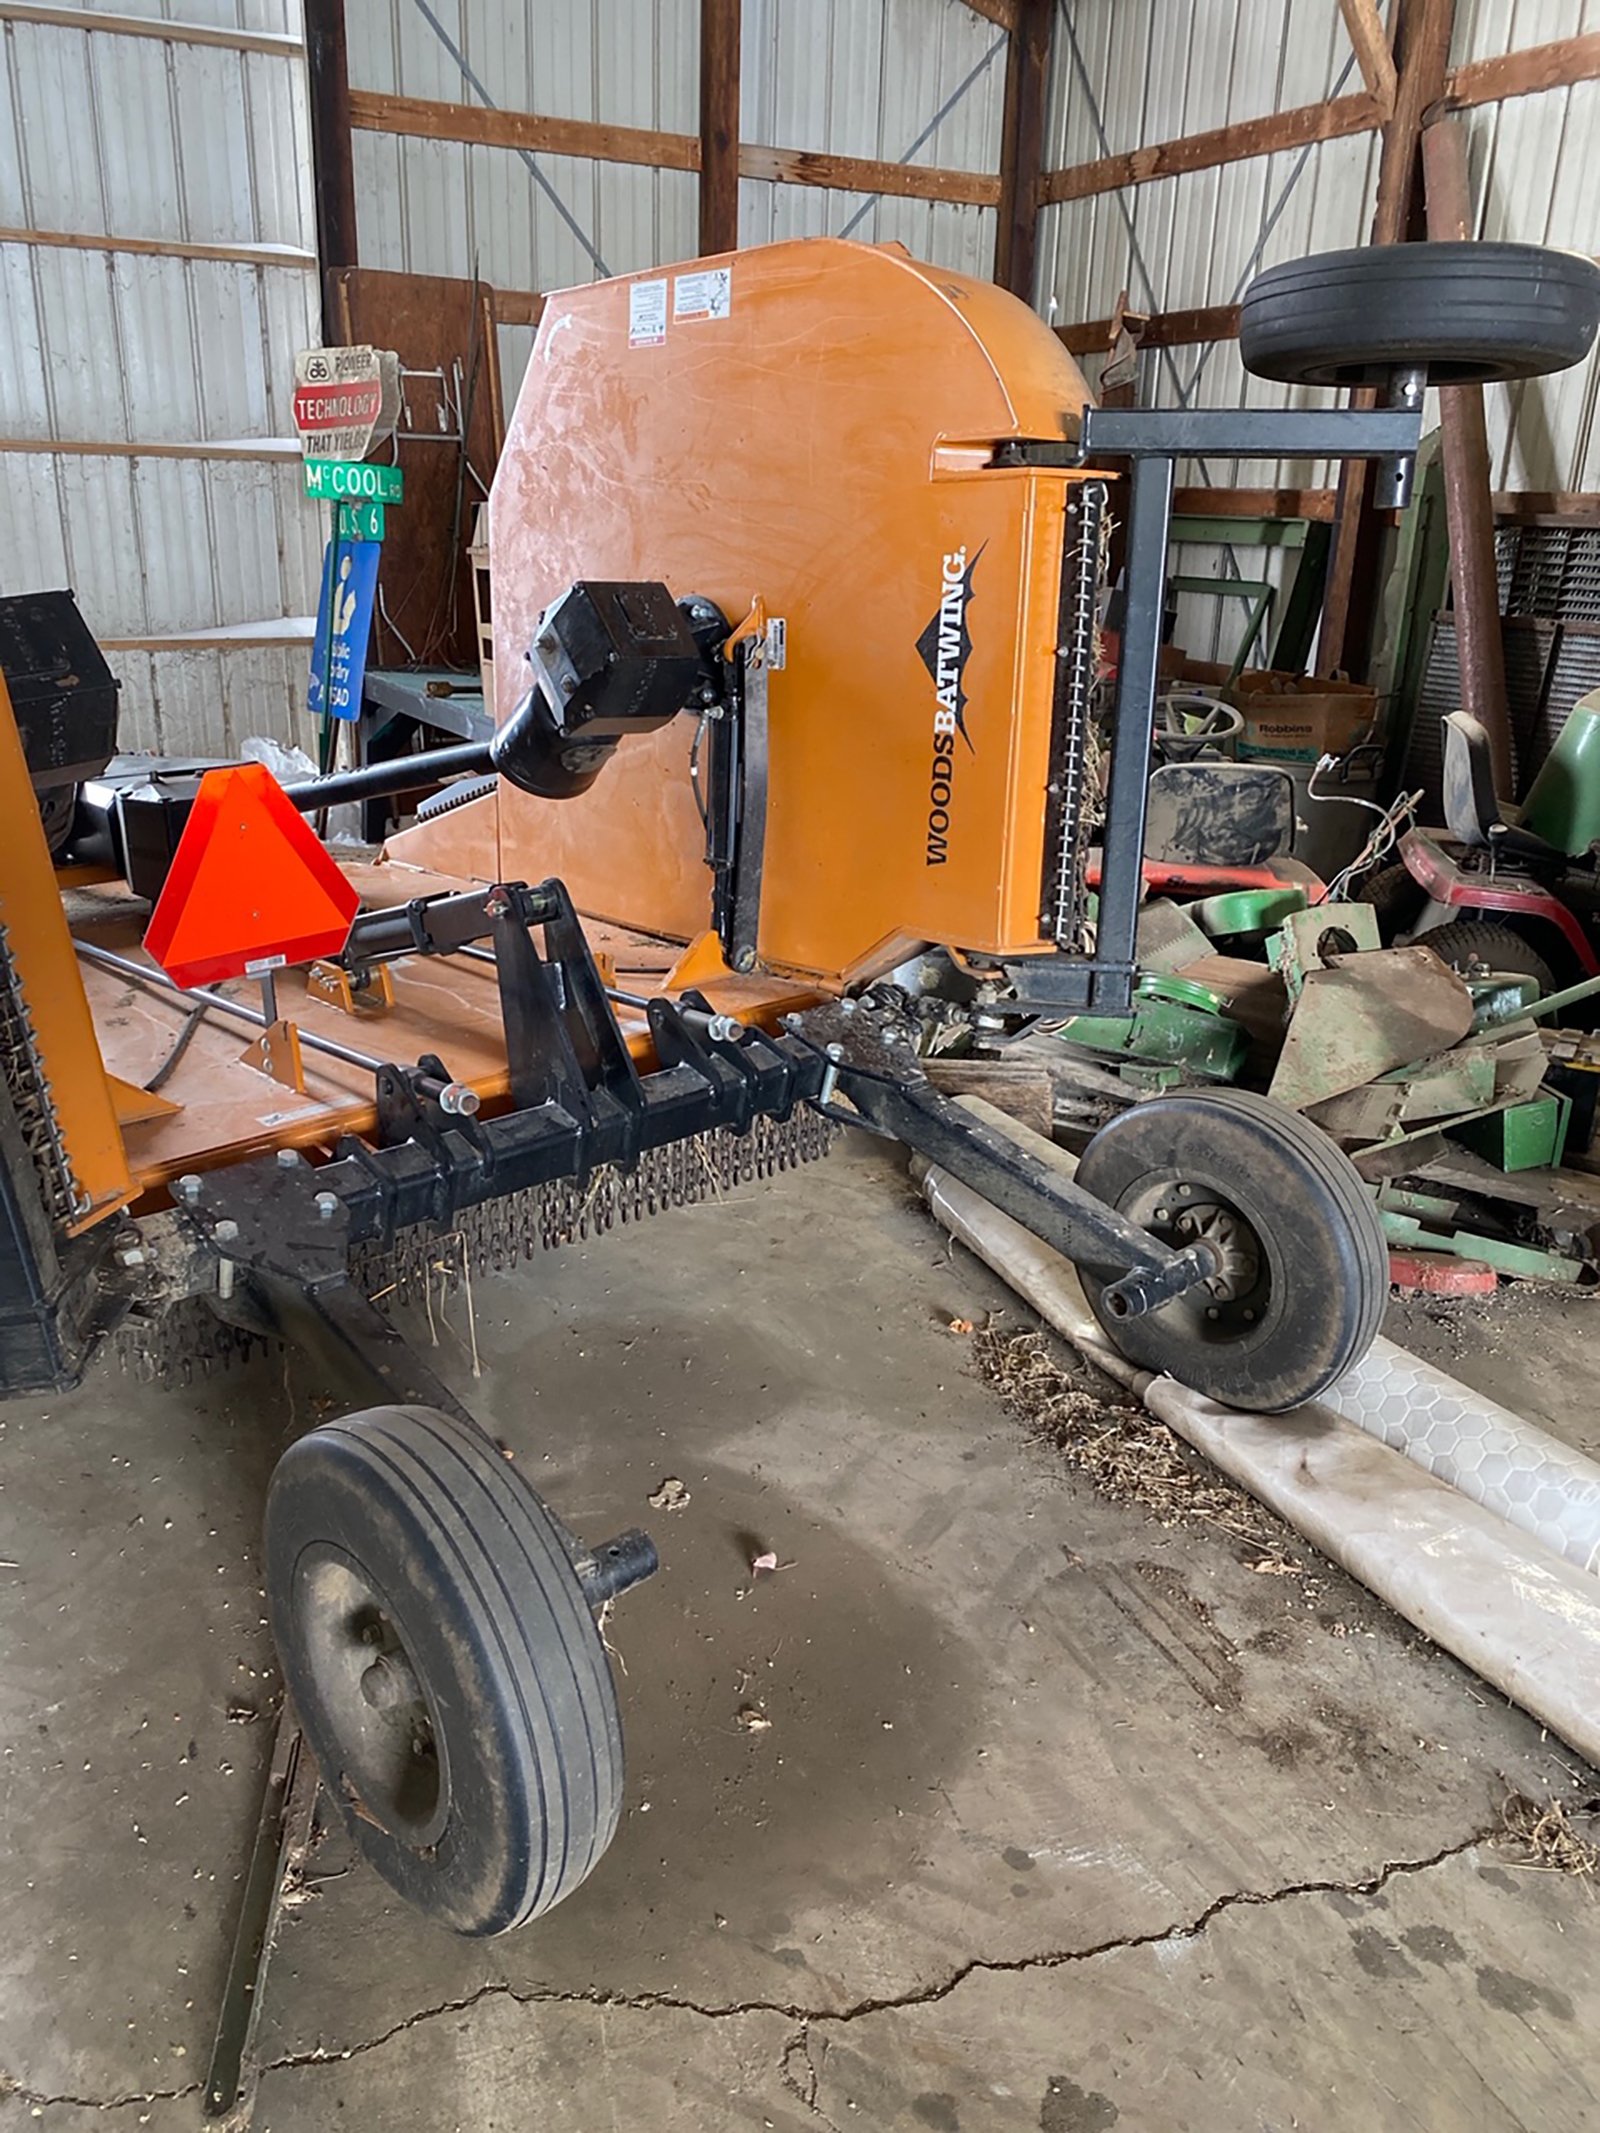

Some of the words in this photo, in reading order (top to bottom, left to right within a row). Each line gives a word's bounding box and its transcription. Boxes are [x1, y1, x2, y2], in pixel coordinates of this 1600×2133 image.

[297, 393, 377, 420] TECHNOLOGY
[307, 434, 332, 454] THAT
[370, 508, 378, 534] 6
